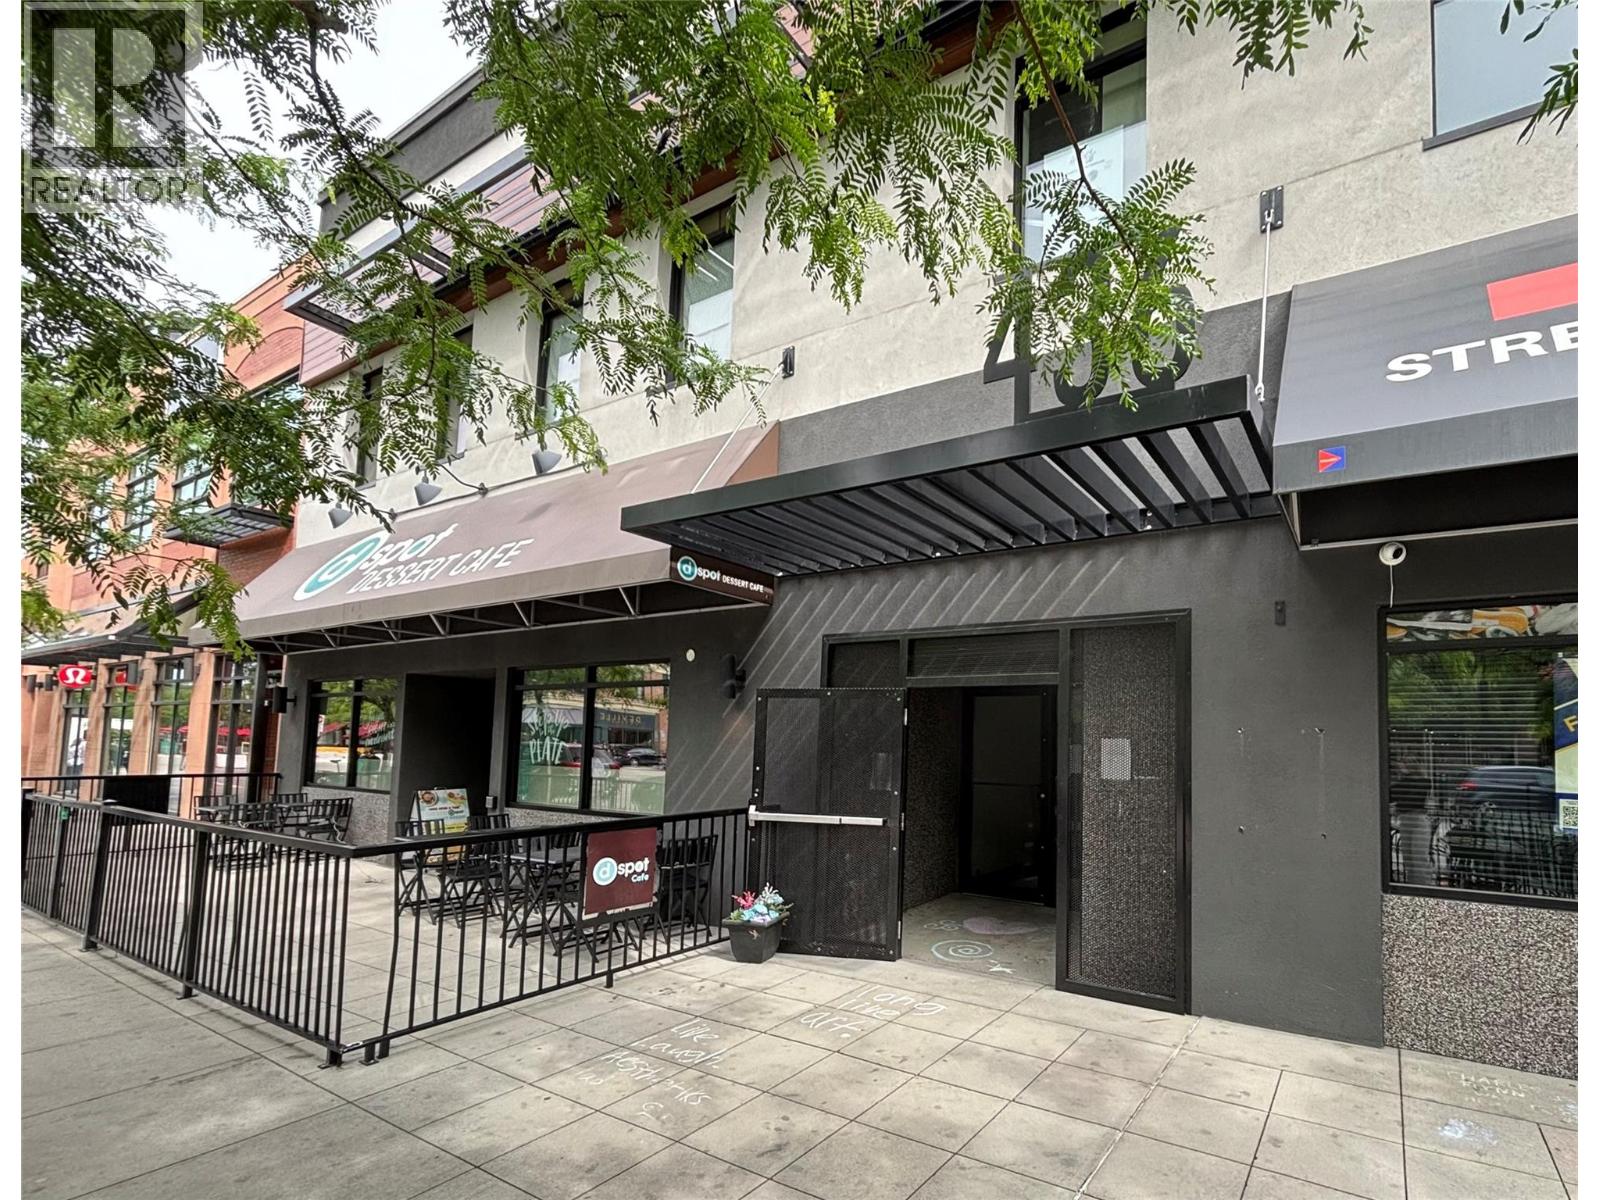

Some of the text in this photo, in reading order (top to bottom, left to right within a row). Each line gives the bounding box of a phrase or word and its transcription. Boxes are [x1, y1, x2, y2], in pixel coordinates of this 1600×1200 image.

[346, 538, 535, 594] DESSERT CAFE
[722, 575, 749, 589] DESSERT
[749, 582, 764, 593] CAFE
[631, 873, 650, 883] Cafe
